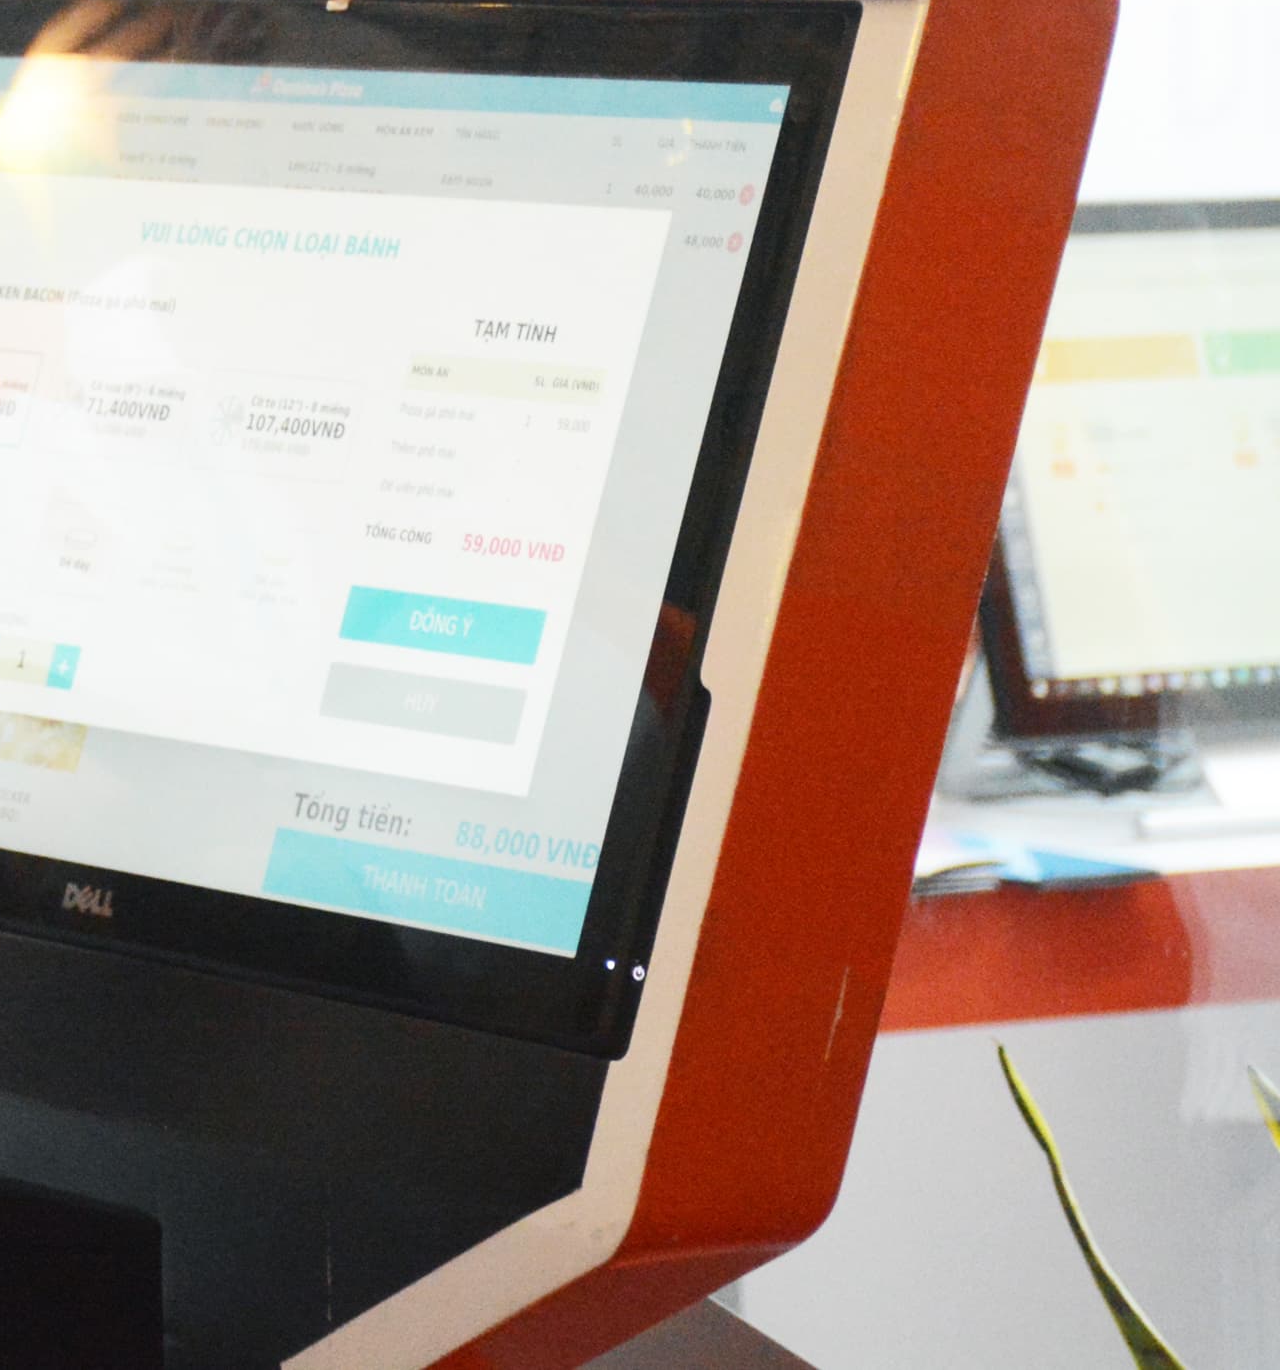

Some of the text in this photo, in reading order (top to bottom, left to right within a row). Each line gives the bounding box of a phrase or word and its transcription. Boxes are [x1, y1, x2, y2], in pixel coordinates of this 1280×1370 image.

[138, 216, 403, 262] VUI LÒNG CHỌN LOẠI BÁNH
[22, 285, 65, 304] BACON
[474, 318, 559, 344] TẠM TÍNH
[245, 411, 346, 442] 107,400VNĐ
[460, 531, 567, 563] 59,000 VNĐ
[456, 821, 541, 861] 88,000
[362, 864, 426, 900] THANH
[61, 881, 114, 918] DELL
